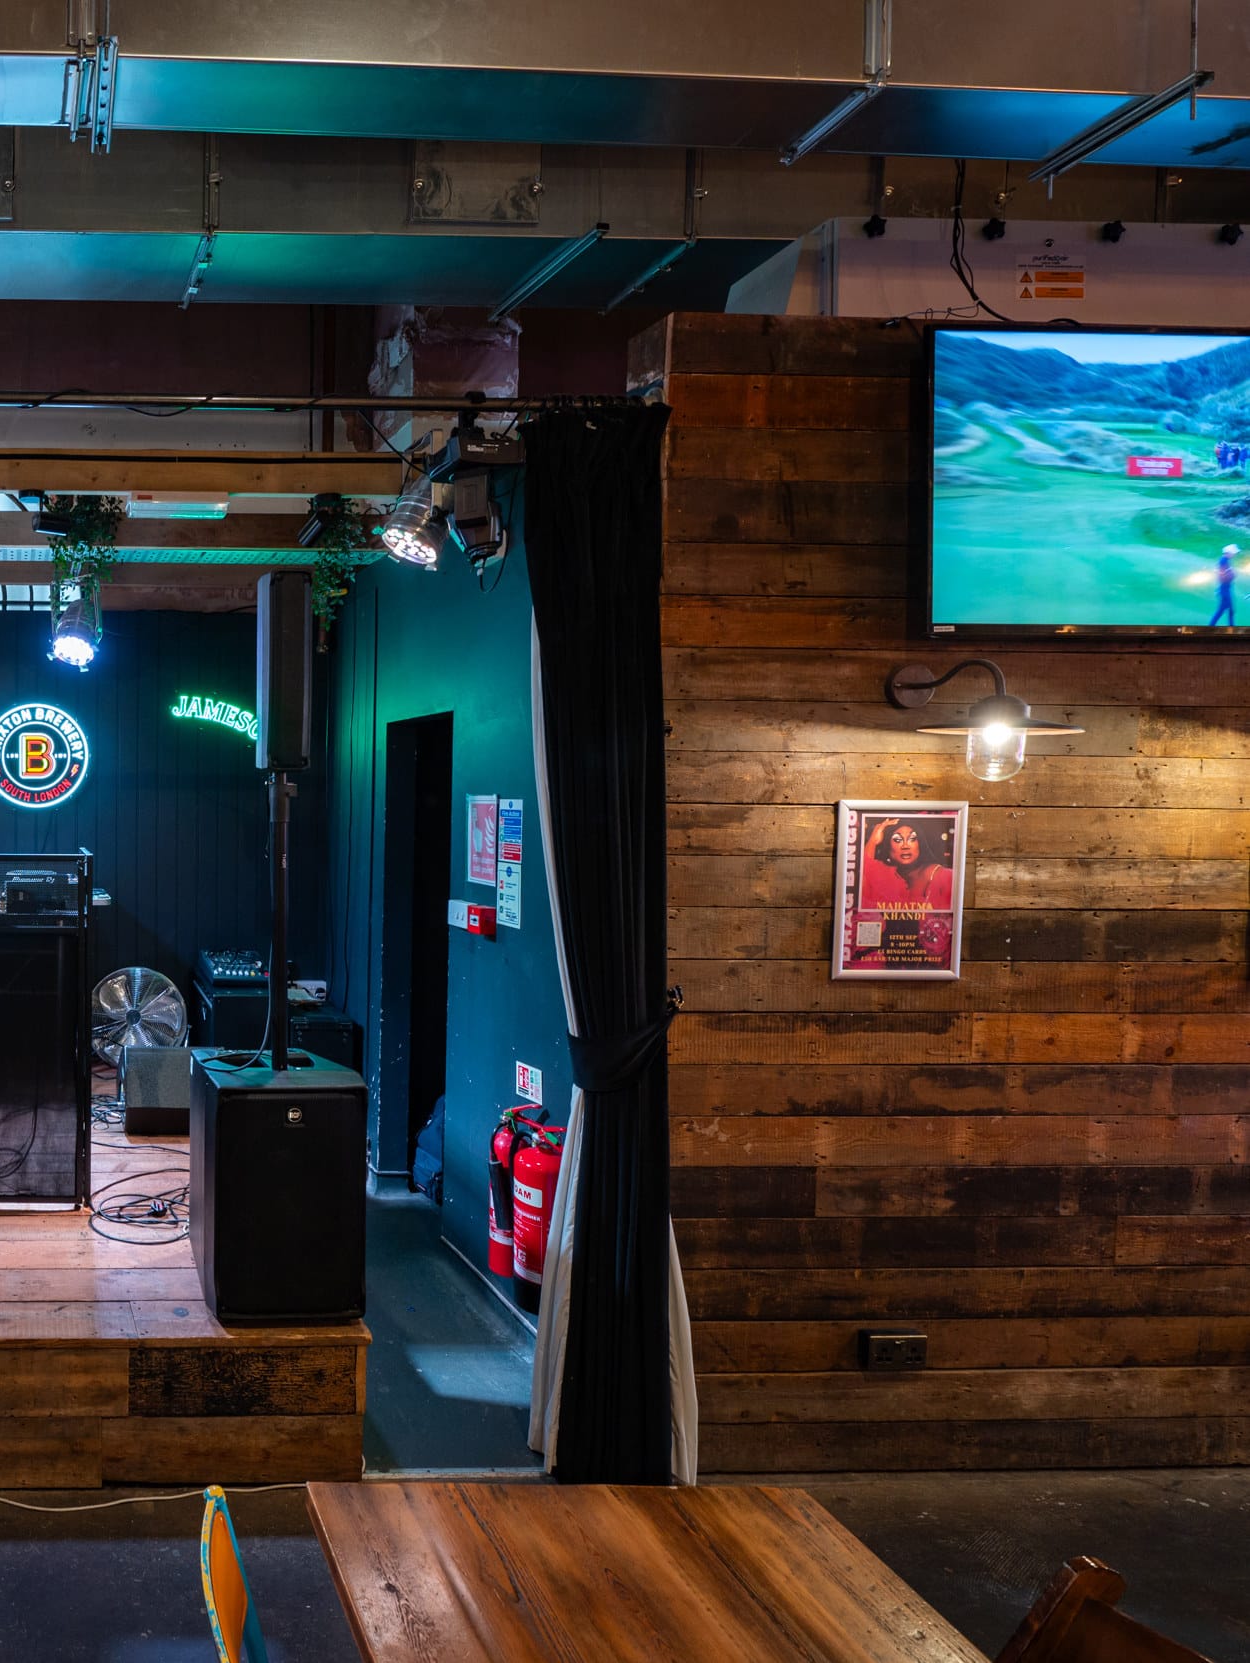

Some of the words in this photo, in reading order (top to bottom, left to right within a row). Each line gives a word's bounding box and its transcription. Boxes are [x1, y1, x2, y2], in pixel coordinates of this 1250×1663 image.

[35, 707, 84, 760] BREWERY
[19, 732, 56, 779] B
[0, 778, 31, 802] SOUTH
[34, 778, 72, 802] LONDON
[877, 901, 933, 910] MAHATMA
[883, 912, 926, 921] KHANDI
[514, 1185, 532, 1201] OAM
